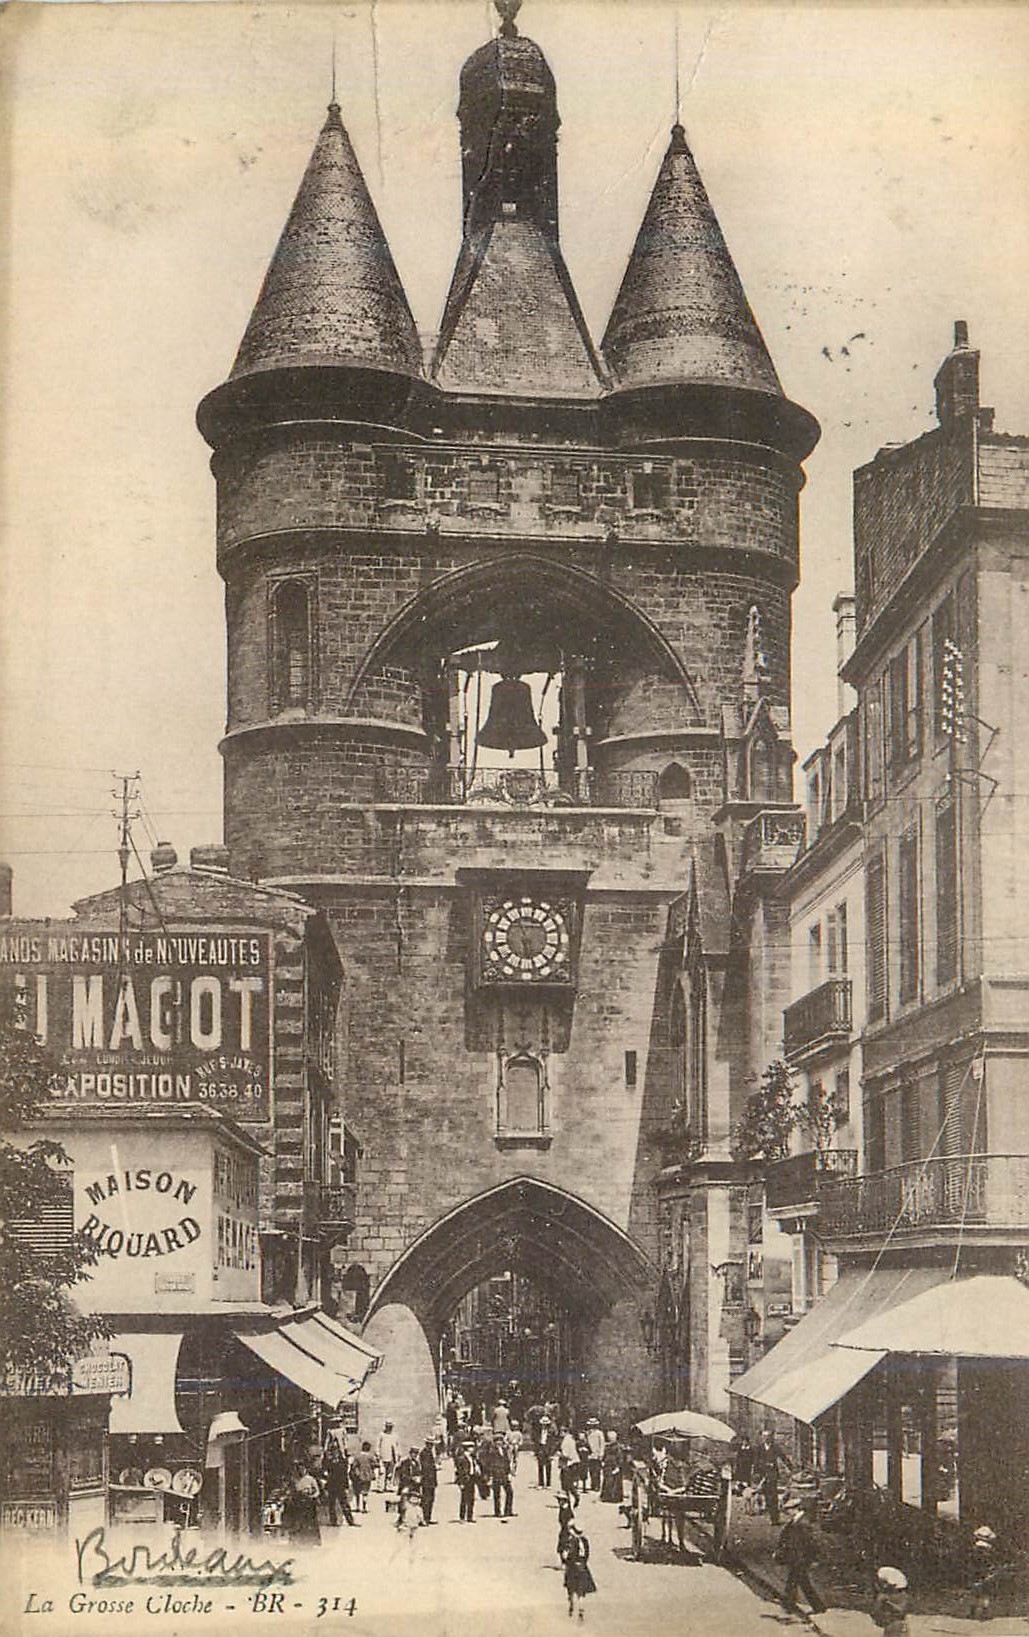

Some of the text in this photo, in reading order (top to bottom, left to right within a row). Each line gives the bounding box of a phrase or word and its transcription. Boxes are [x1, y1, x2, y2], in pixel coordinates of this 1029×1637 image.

[134, 941, 152, 964] de
[72, 974, 263, 1051] MAGOT
[84, 1170, 197, 1206] MAISON
[79, 1213, 202, 1258] RIQUARD
